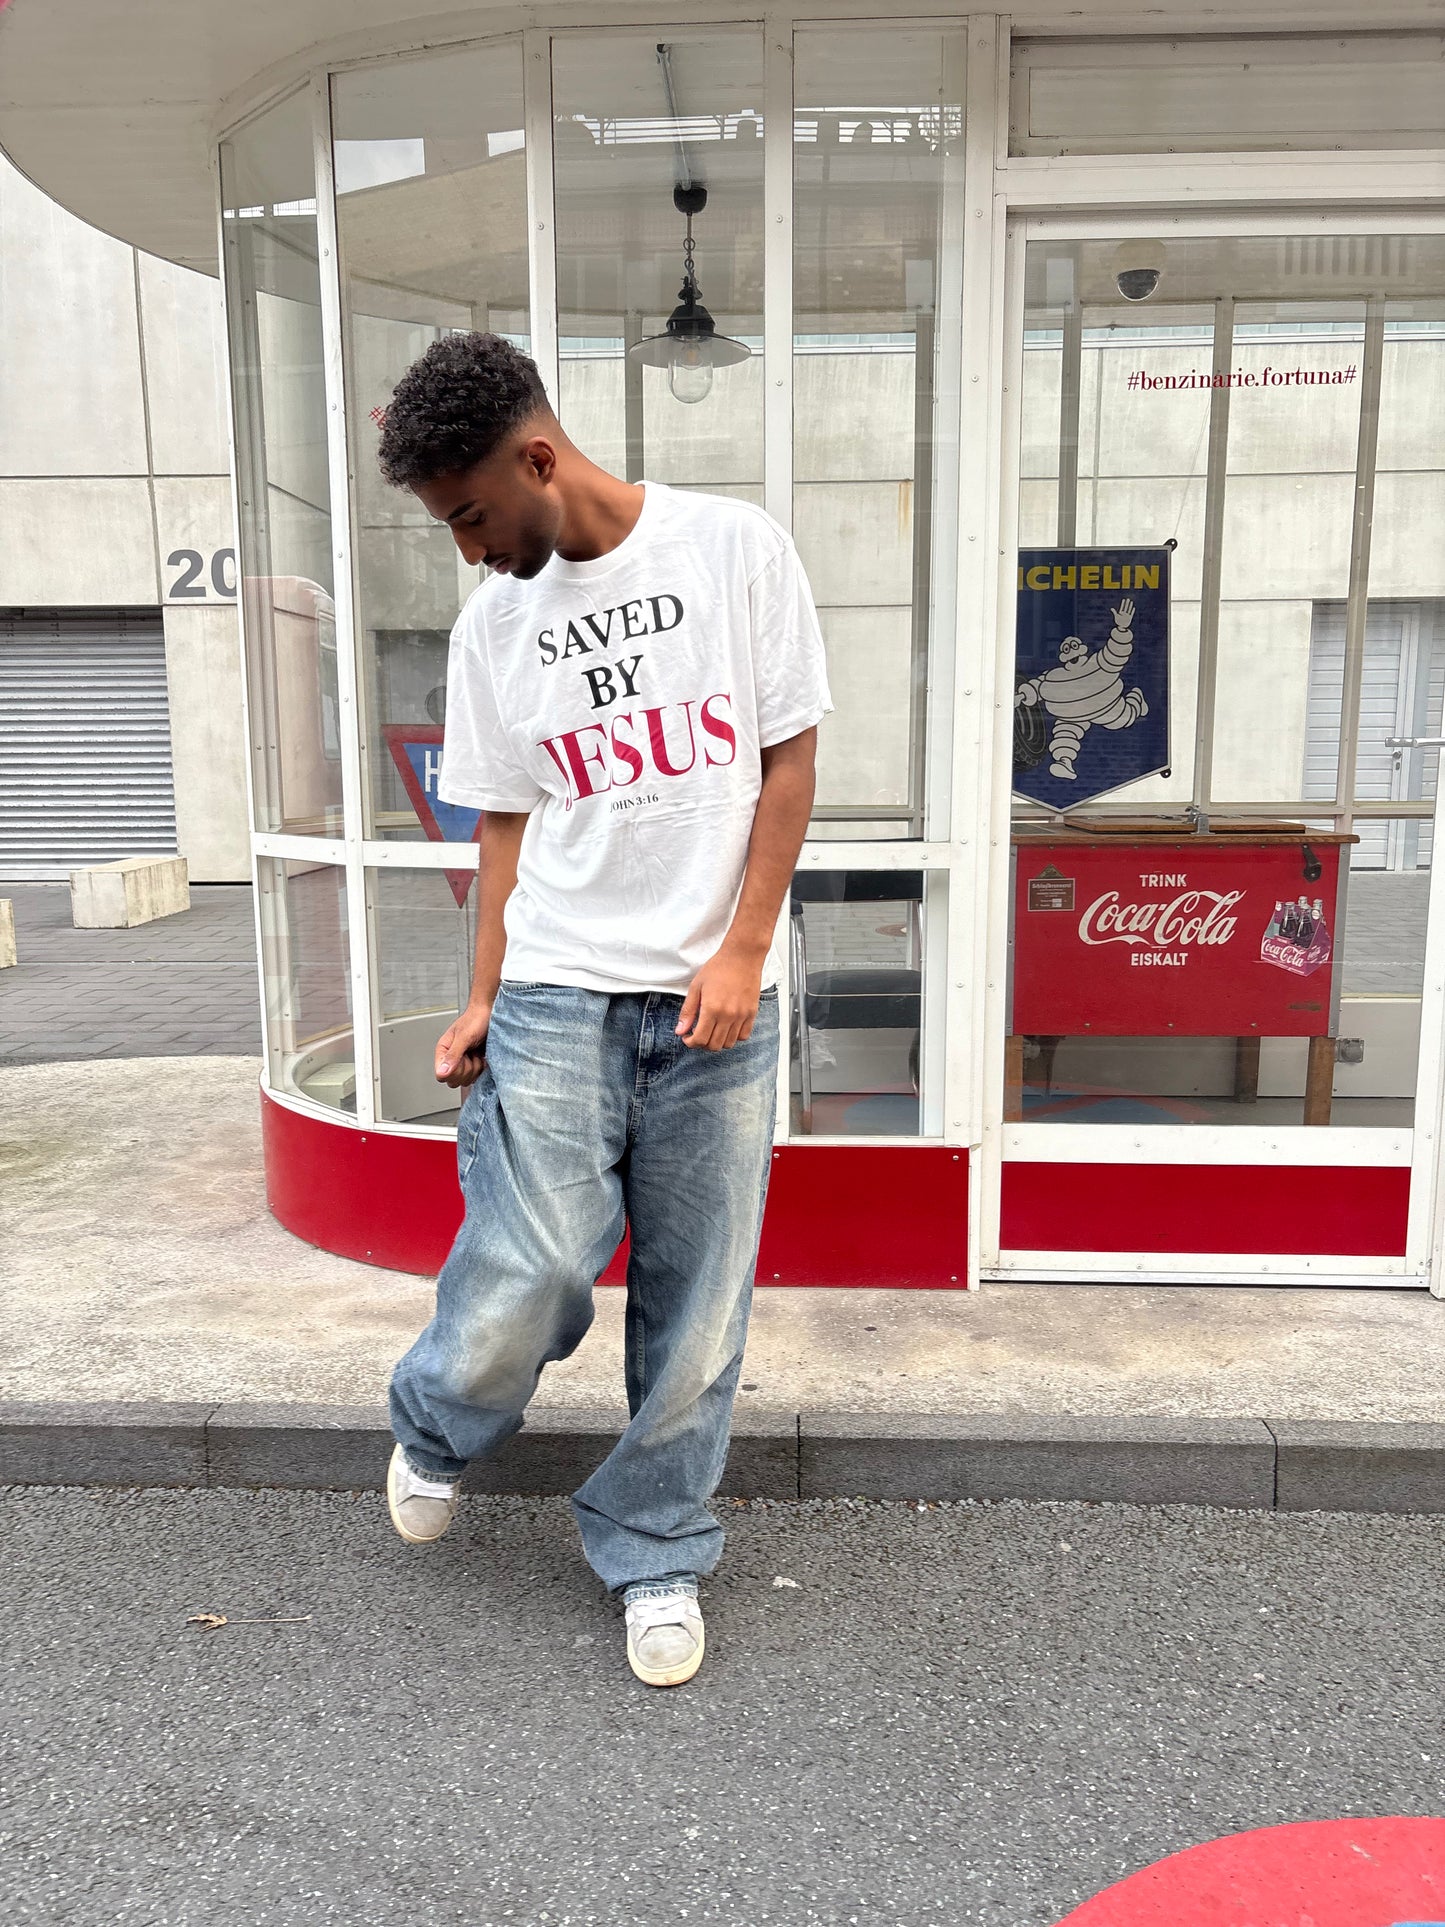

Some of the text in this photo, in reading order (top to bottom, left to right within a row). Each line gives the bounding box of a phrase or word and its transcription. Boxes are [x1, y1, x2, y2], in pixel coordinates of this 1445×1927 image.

[167, 548, 237, 598] 20
[537, 594, 684, 667] SAVED
[581, 654, 644, 710] BY
[536, 692, 736, 812] JESUS
[610, 793, 659, 813] JOHN 3:16
[1139, 874, 1187, 888] TRINK
[1078, 890, 1247, 946] Coca-Cola
[1131, 953, 1188, 966] EISKALT
